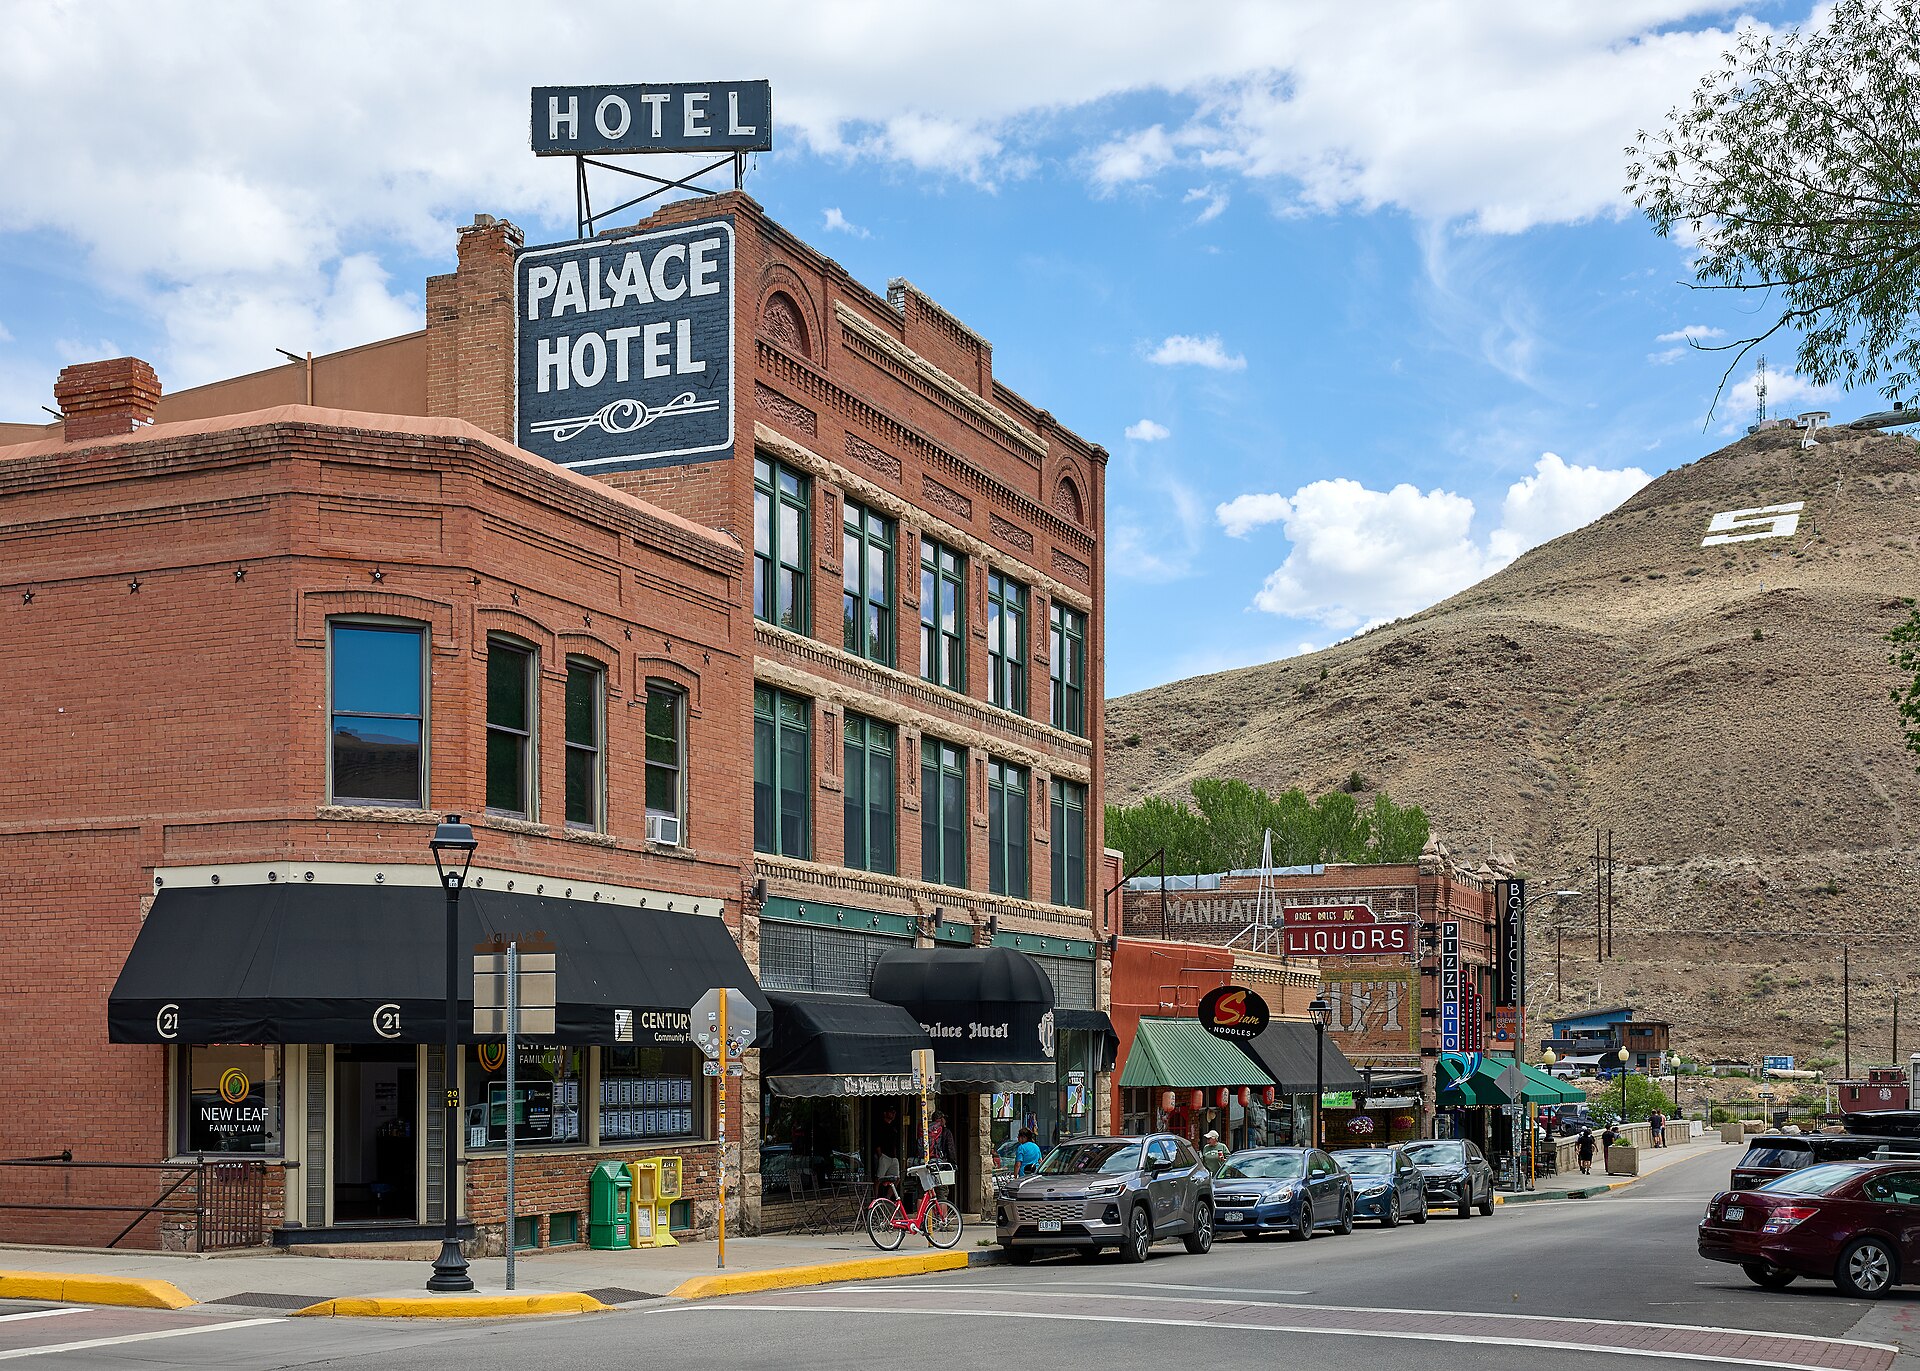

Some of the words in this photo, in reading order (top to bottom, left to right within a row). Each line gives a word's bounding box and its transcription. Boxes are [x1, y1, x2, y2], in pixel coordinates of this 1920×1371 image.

[548, 90, 756, 141] HOTEL
[528, 237, 721, 321] PALACE
[537, 318, 706, 393] HOTEL
[1701, 501, 1805, 547] S
[1289, 929, 1405, 953] LIQUORS
[1508, 883, 1521, 1001] BOATHOUSE
[1213, 990, 1260, 1025] Siam
[654, 1031, 685, 1044] Community
[968, 1022, 1009, 1040] Hotel
[1213, 1026, 1251, 1037] NOODLES
[519, 1054, 546, 1065] FAMILY
[547, 1054, 564, 1064] LAW
[447, 1090, 459, 1099] 20
[447, 1099, 459, 1108] 17
[201, 1107, 234, 1121] NEW
[236, 1107, 270, 1122] LEAF
[209, 1124, 240, 1132] FAMILY
[241, 1124, 261, 1132] LAW
